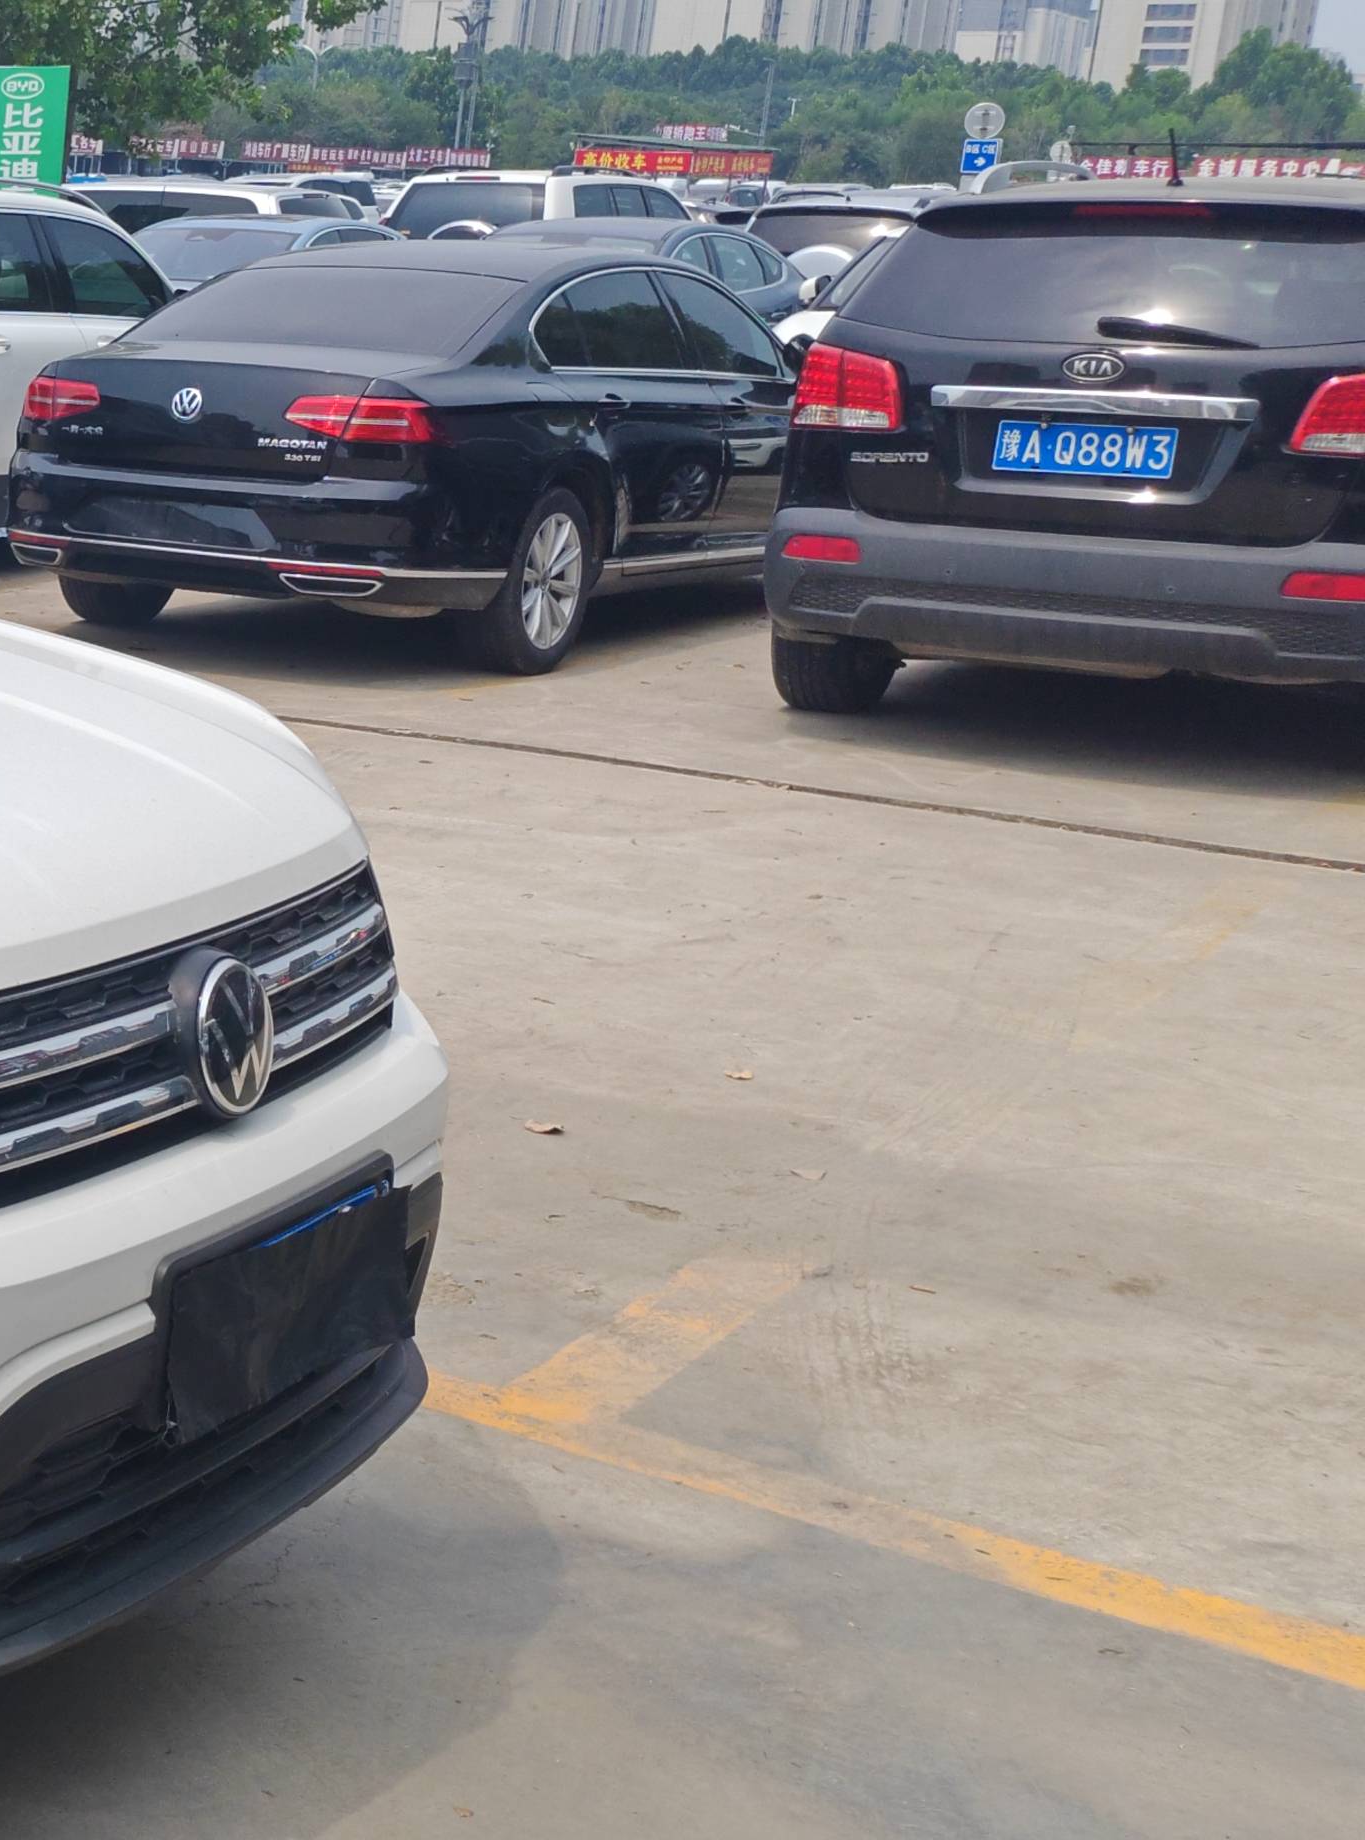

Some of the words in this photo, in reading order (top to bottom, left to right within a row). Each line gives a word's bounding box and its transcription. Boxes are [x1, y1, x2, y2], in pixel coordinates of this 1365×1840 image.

[6, 80, 40, 92] BYD
[0, 102, 44, 192] 比亚迪
[583, 151, 647, 170] 高价收车
[1072, 360, 1114, 377] KIA
